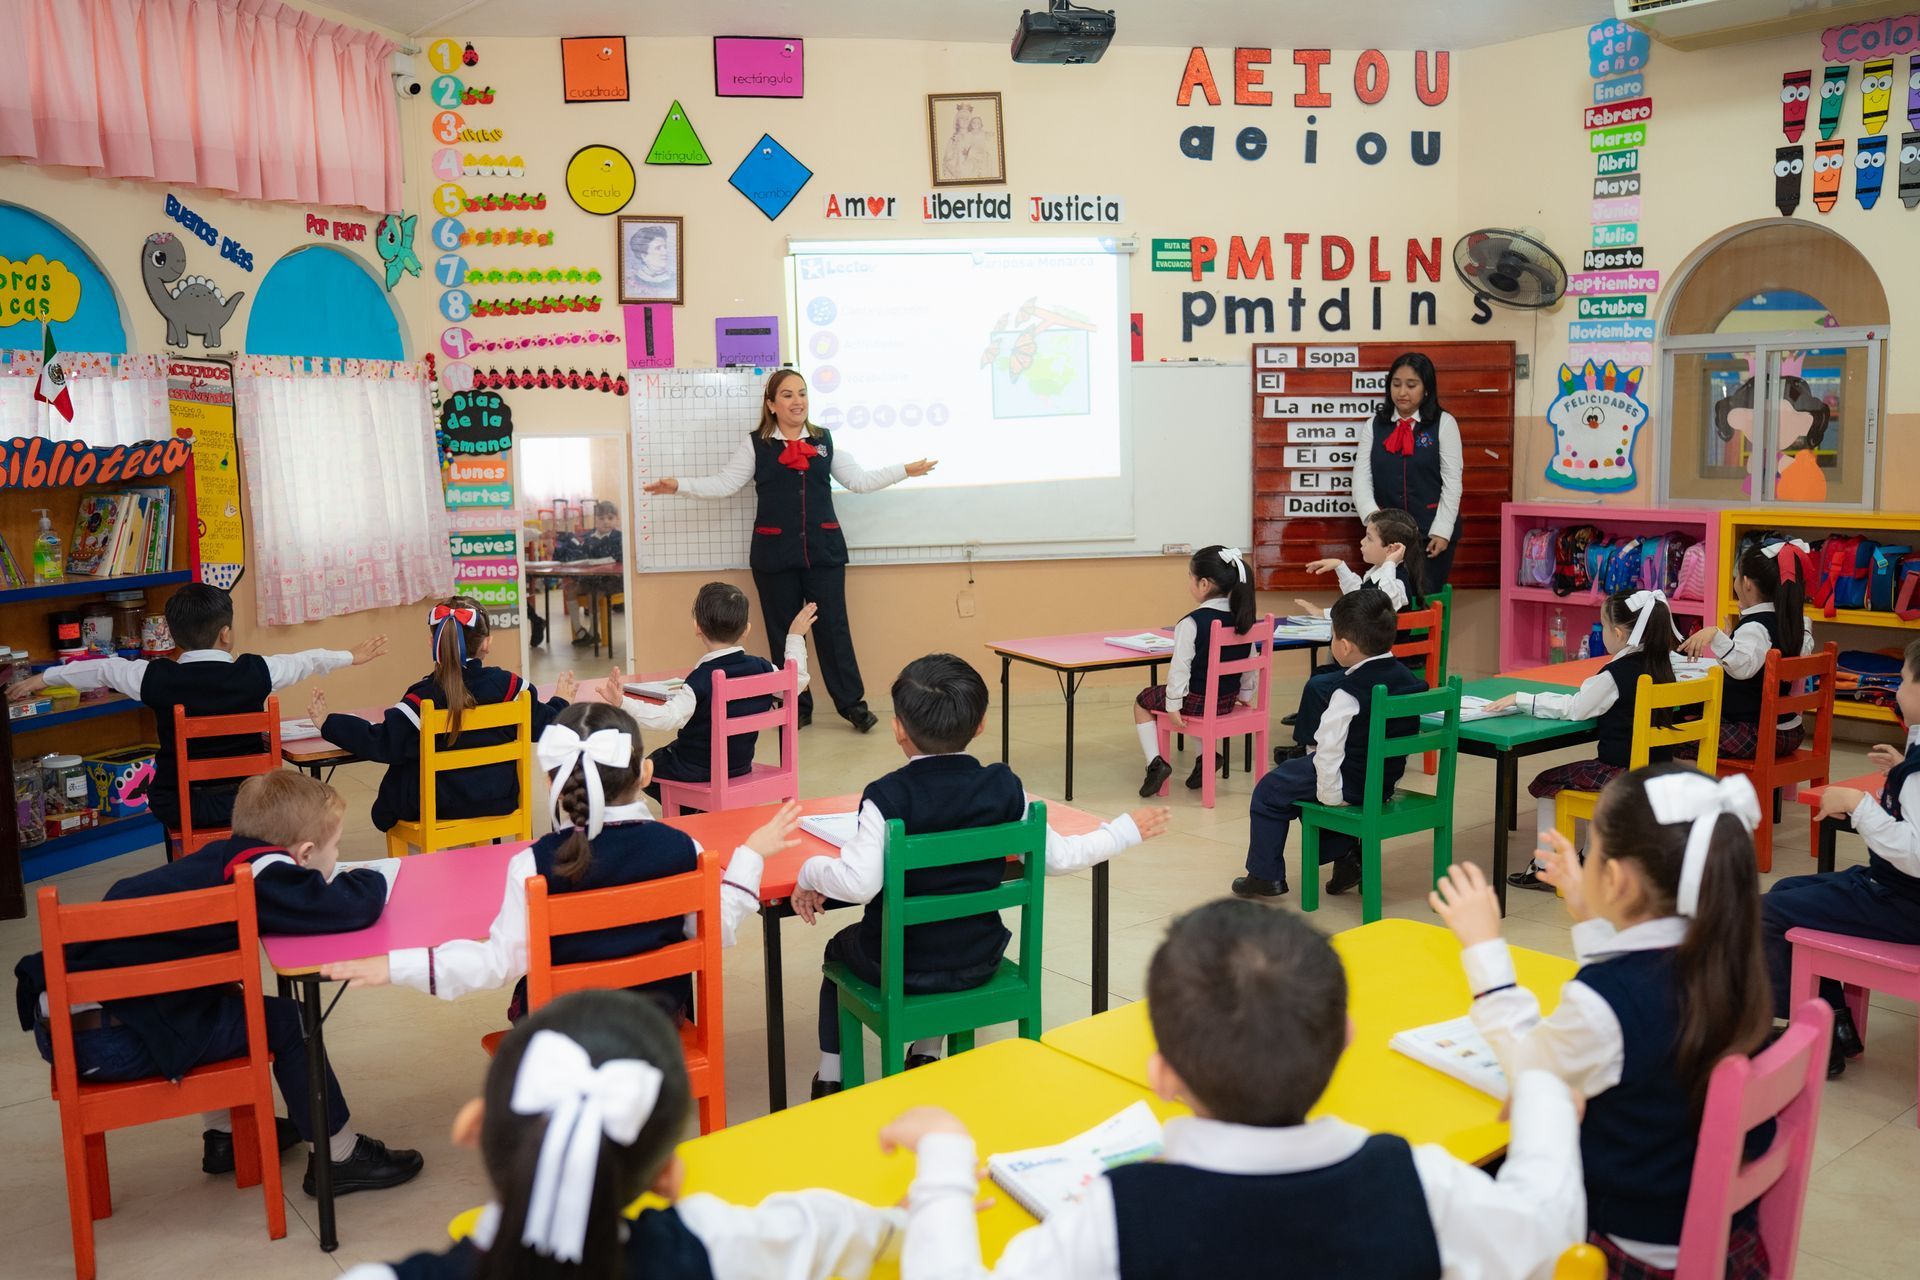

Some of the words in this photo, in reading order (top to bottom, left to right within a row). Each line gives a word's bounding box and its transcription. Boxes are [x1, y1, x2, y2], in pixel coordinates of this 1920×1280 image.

[1603, 35, 1632, 56] del
[1838, 20, 1920, 55] Colo
[436, 43, 450, 70] 1
[733, 72, 793, 86] rectángulo
[438, 78, 457, 106] 2
[569, 85, 625, 98] cuadrado
[1595, 82, 1641, 100] Enero
[1586, 106, 1650, 127] Febrero
[440, 114, 457, 141] 3
[1592, 131, 1643, 148] Marzo
[440, 149, 460, 177] 4
[654, 150, 704, 163] triángulo
[1598, 151, 1637, 172] Abril
[582, 184, 621, 198] círculo
[753, 184, 791, 199] rombo
[1595, 180, 1639, 195] Mayo
[442, 187, 459, 214] 5
[923, 193, 1011, 220] Libertad
[1031, 195, 1119, 222] Justicia
[165, 193, 219, 246] Buenos
[1593, 203, 1639, 219] Junio
[306, 213, 329, 236] Por
[333, 221, 367, 242] Favor
[440, 219, 458, 247] 6
[1594, 227, 1635, 244] Julio
[1585, 250, 1643, 268] Agosto
[440, 256, 460, 286] 7
[1567, 274, 1656, 293] Septiembre
[447, 291, 466, 319] 8
[1580, 299, 1644, 316] Octubre
[1570, 322, 1653, 340] Noviembre
[444, 328, 465, 358] 9
[719, 352, 776, 363] horizontal
[1264, 349, 1288, 364] La
[1310, 352, 1355, 366] sopa
[445, 364, 472, 391] 10
[1261, 374, 1280, 389] El
[646, 375, 749, 399] Miércoles
[454, 392, 501, 411] Días
[1274, 400, 1299, 414] La
[1563, 394, 1639, 418] FELICIDADES
[447, 412, 471, 429] de
[482, 411, 502, 427] la
[1296, 427, 1335, 438] ama
[1345, 427, 1355, 438] a
[1297, 449, 1316, 463] El
[450, 462, 505, 480] Lunes
[1300, 473, 1319, 487] El
[447, 489, 510, 503] Martes
[450, 538, 514, 555] Jueves
